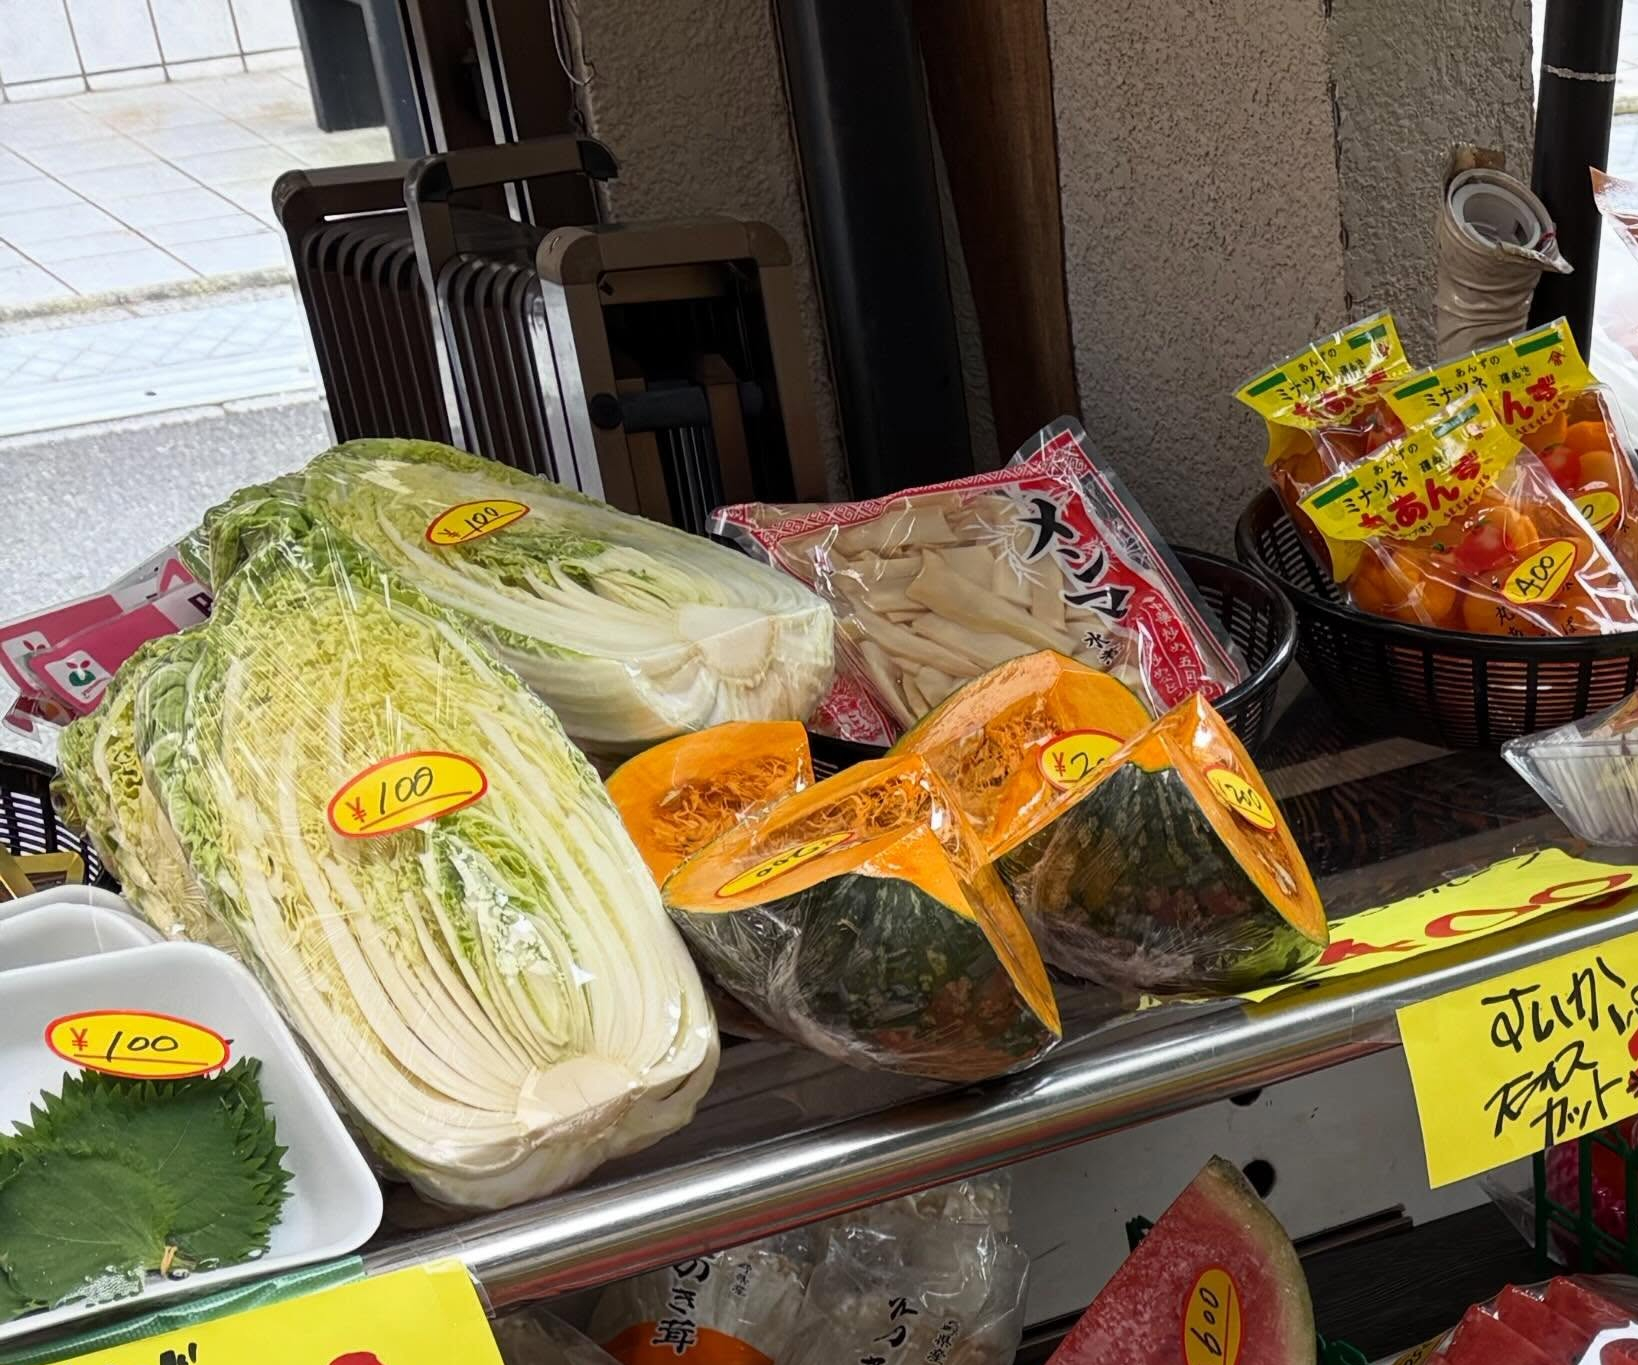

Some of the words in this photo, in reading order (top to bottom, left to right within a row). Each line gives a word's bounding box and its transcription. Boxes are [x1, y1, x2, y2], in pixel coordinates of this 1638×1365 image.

[1018, 497, 1133, 621] メンマ
[1481, 955, 1627, 1053] すいか
